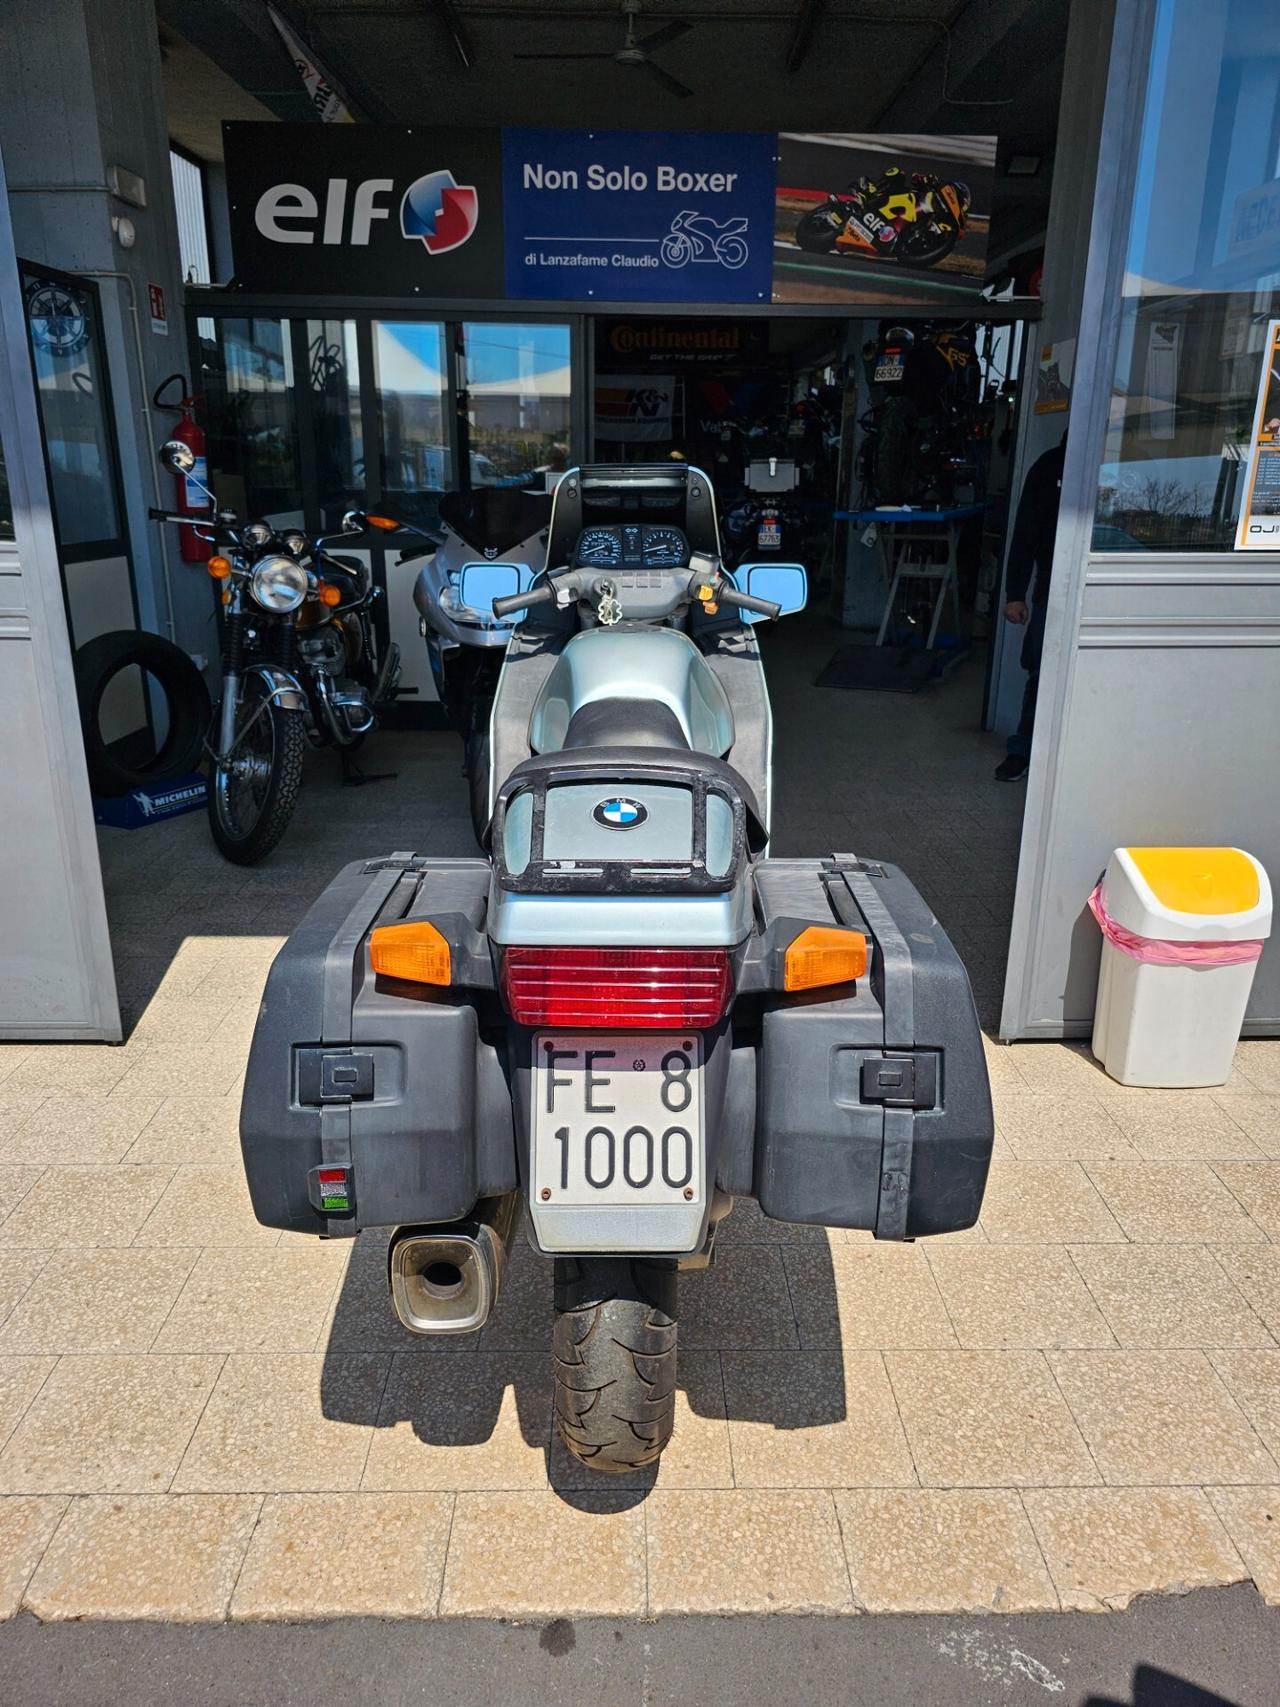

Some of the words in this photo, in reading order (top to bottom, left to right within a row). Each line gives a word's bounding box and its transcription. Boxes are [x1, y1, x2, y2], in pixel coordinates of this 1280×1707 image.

[523, 163, 578, 190] Non
[586, 164, 648, 191] Solo
[657, 166, 738, 193] Boxer
[255, 178, 394, 245] elf
[863, 212, 885, 232] elf
[525, 253, 537, 265] di
[540, 253, 609, 267] Lanzafame
[611, 254, 659, 268] Claudio
[154, 785, 206, 806] MICHELIN
[546, 1050, 616, 1113] FE
[660, 1050, 693, 1113] 8
[555, 1126, 693, 1190] 1000
